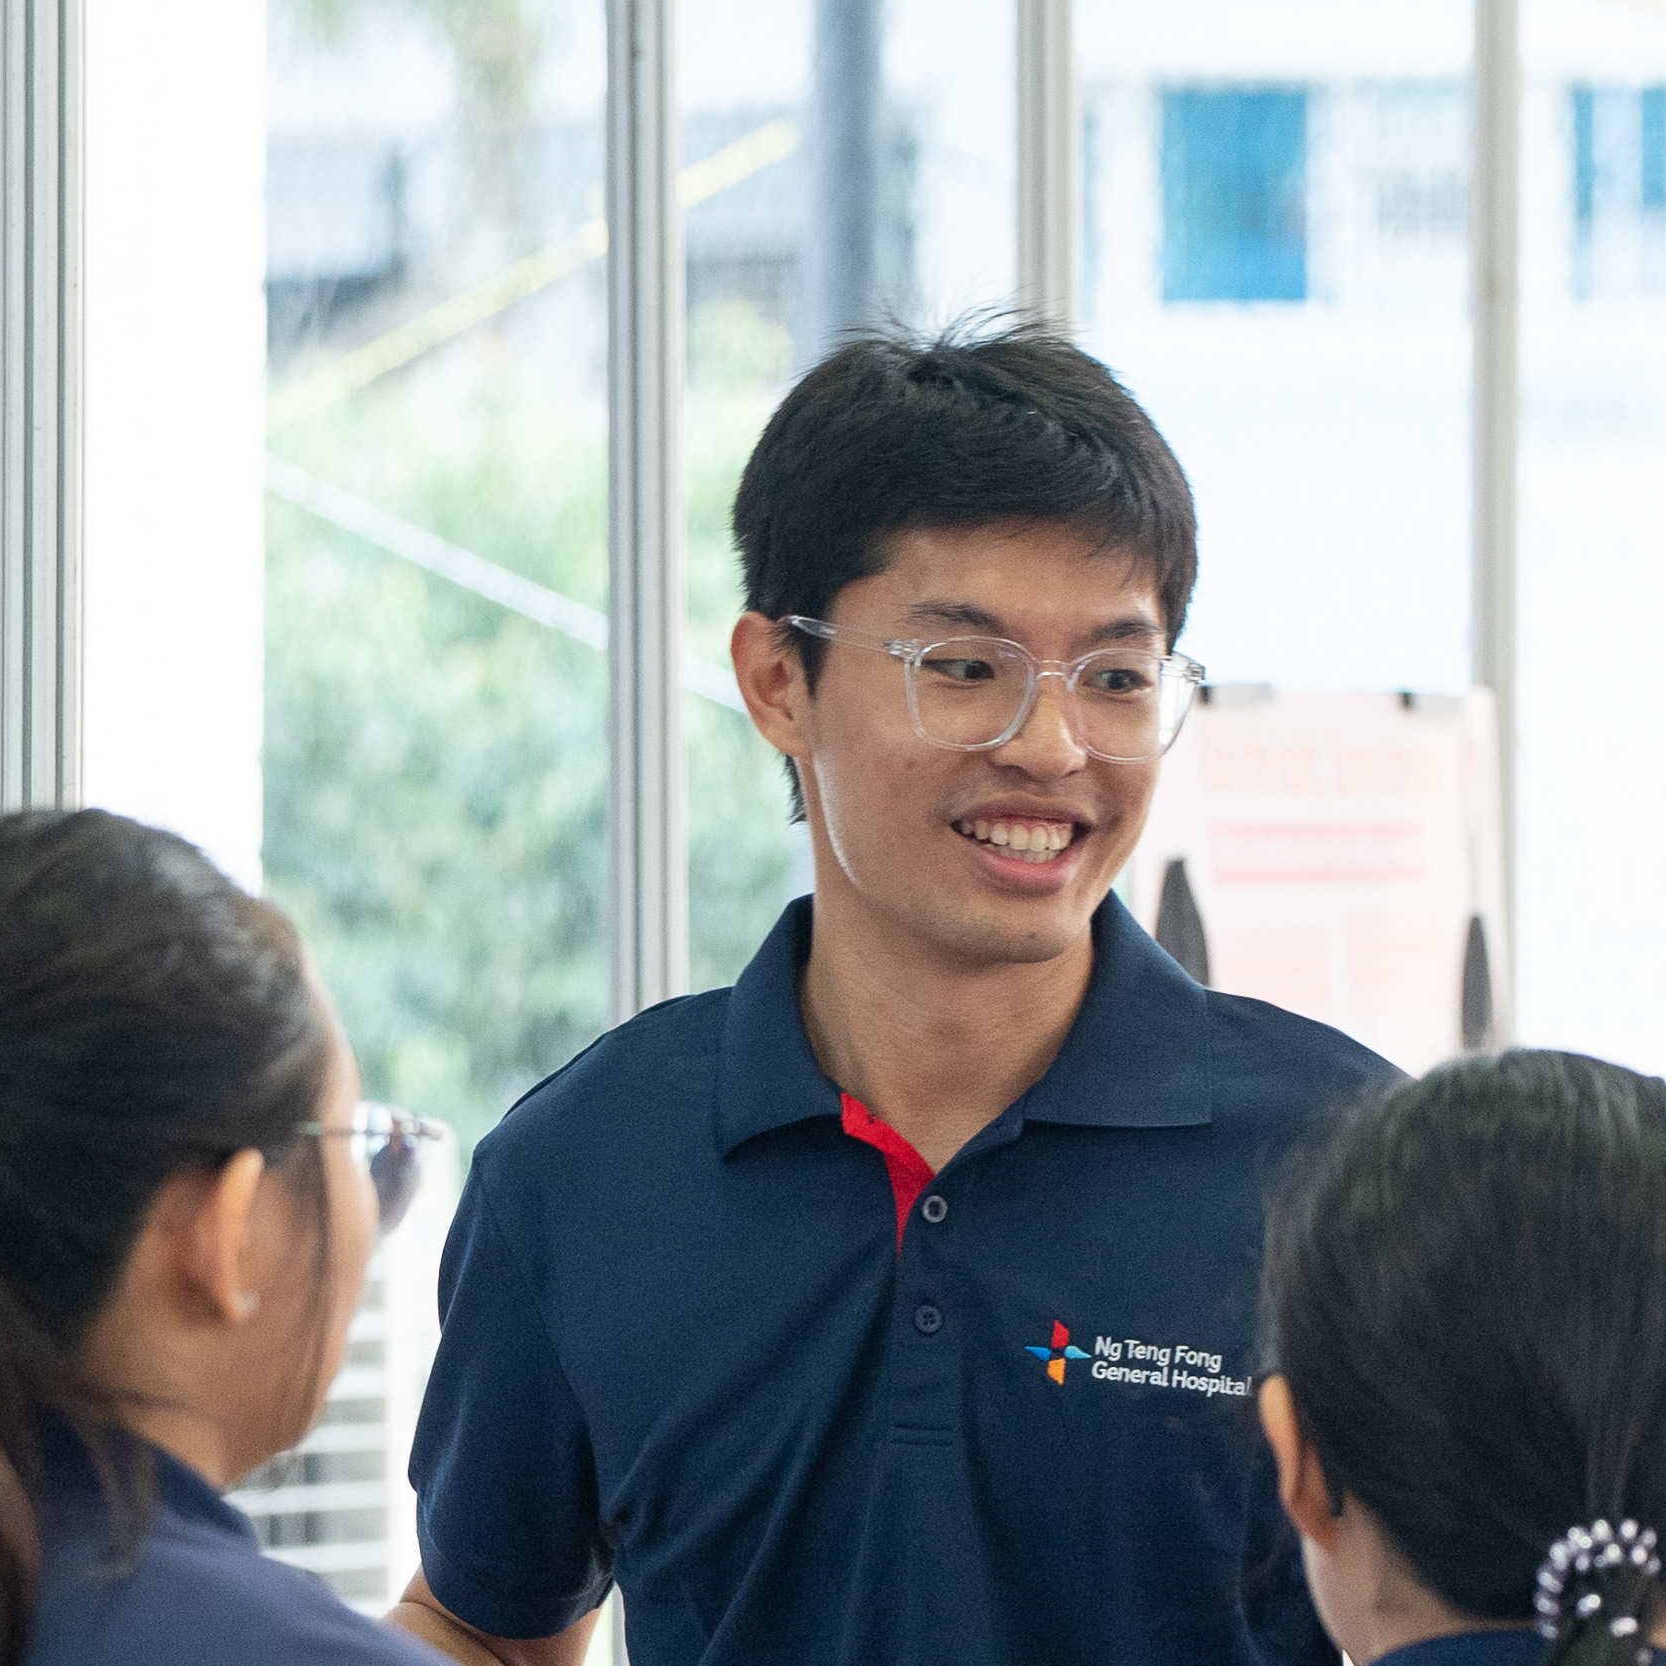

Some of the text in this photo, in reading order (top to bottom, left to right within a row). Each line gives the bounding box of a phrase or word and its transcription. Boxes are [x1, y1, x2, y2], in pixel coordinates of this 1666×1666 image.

[1094, 1336, 1223, 1373] Ng Teng Fong
[1091, 1361, 1252, 1397] General Hospital
